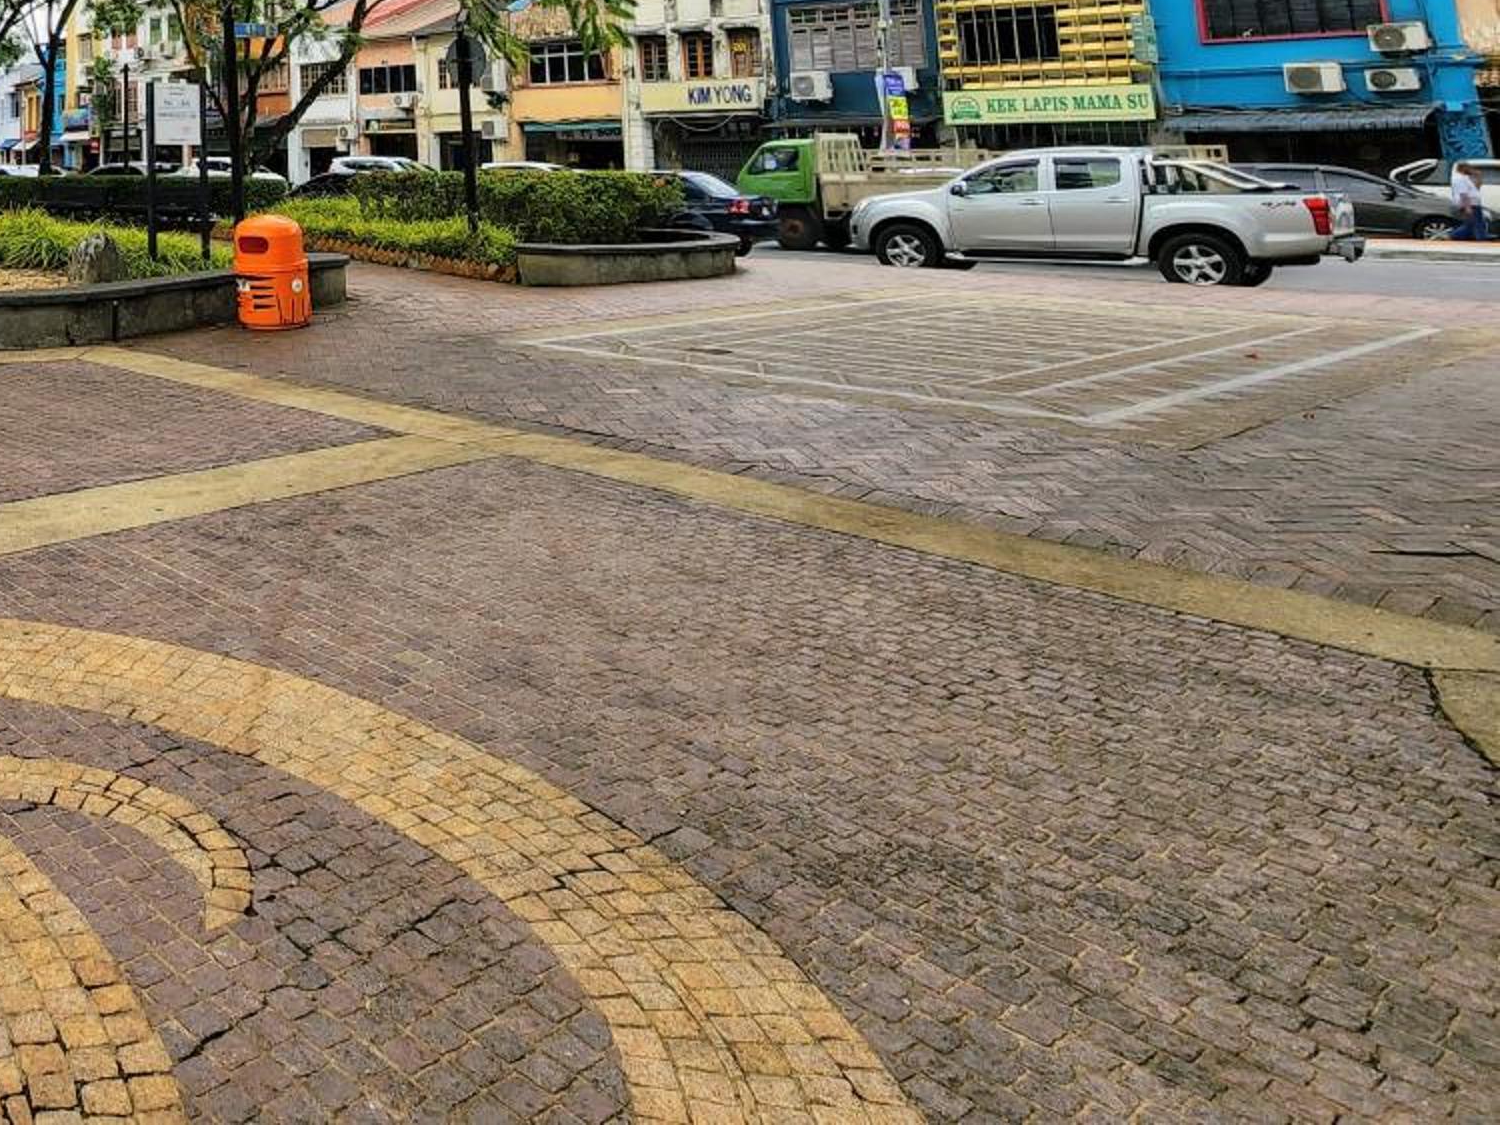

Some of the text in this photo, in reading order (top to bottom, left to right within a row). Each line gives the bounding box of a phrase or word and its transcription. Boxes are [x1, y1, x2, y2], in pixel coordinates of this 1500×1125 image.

[687, 84, 752, 104] KIM YONG
[986, 92, 1149, 114] KEK LAPIS MAMA SU
